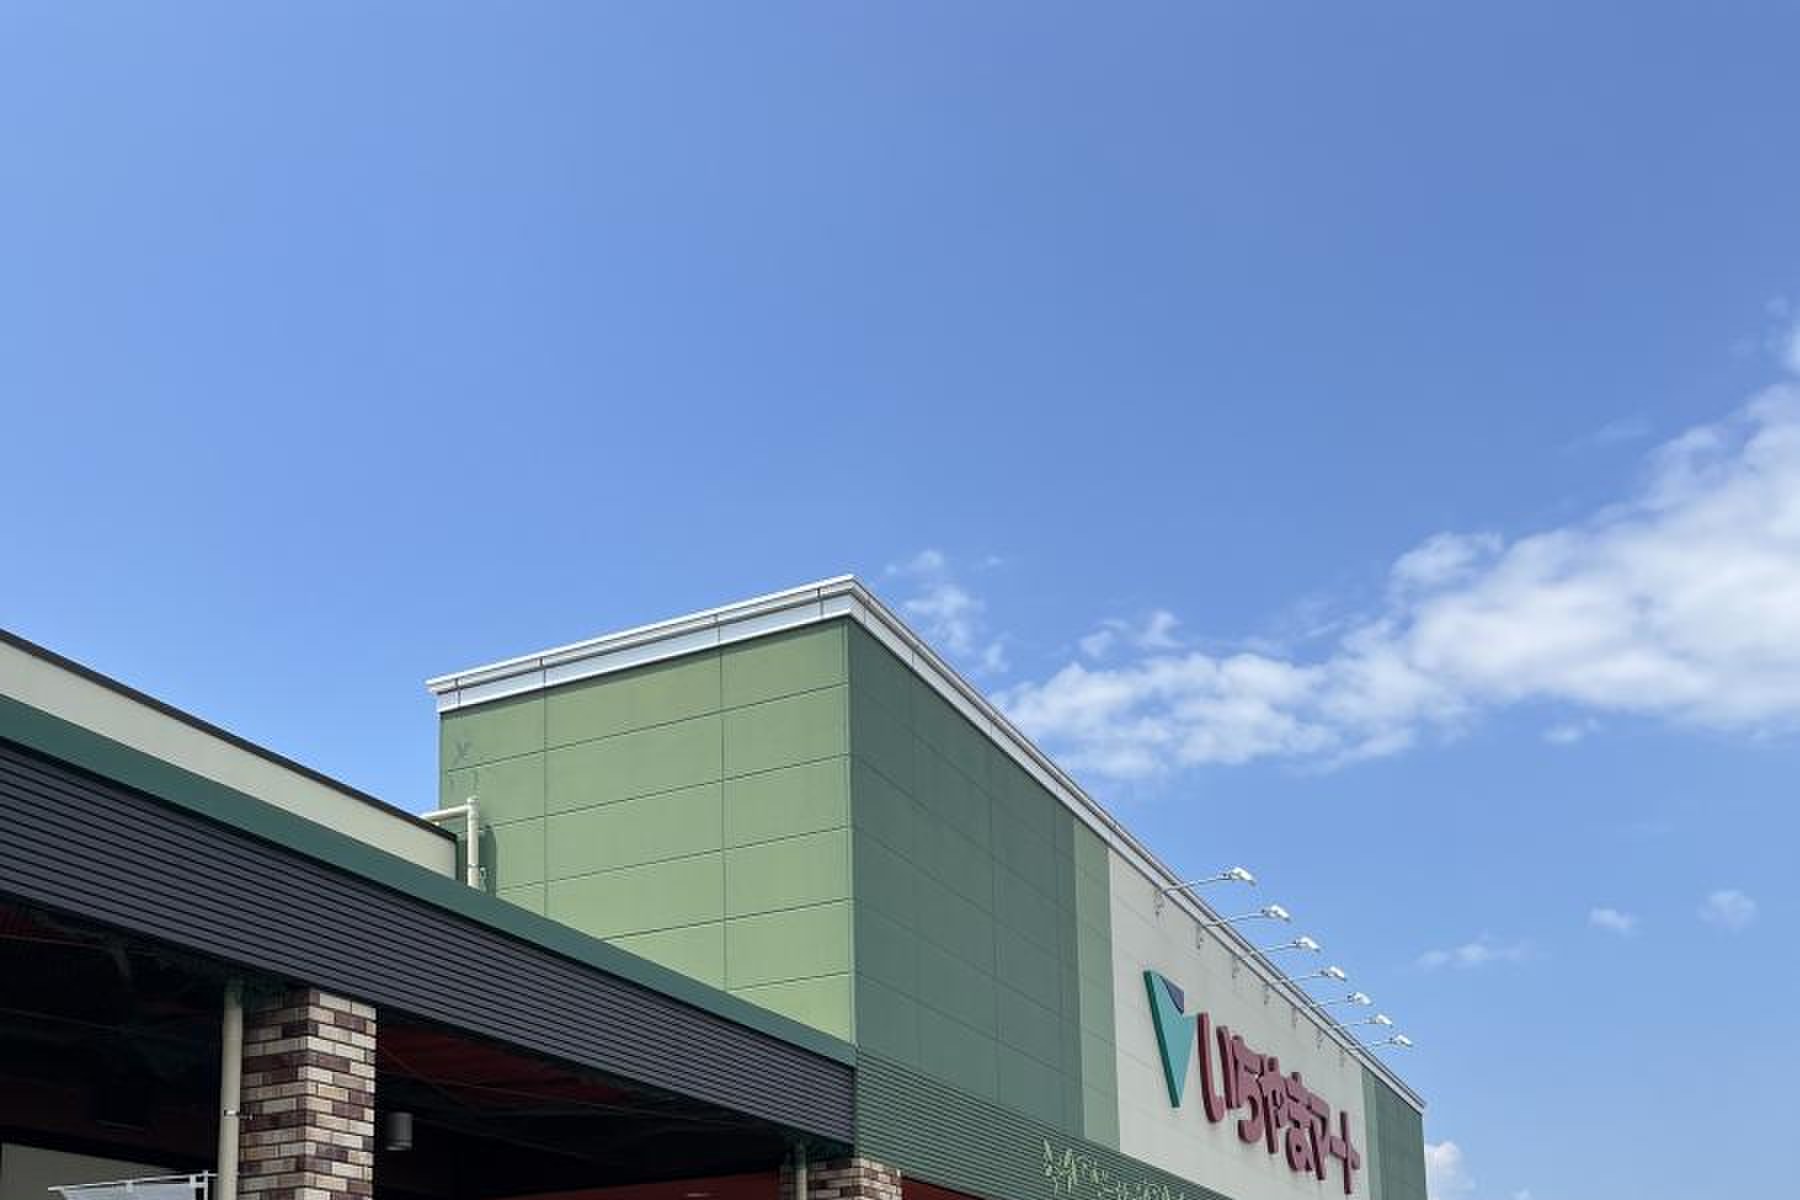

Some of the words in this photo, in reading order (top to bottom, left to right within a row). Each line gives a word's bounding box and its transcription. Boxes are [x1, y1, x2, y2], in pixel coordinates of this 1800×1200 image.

[1198, 1012, 1361, 1196] いちやまマート
